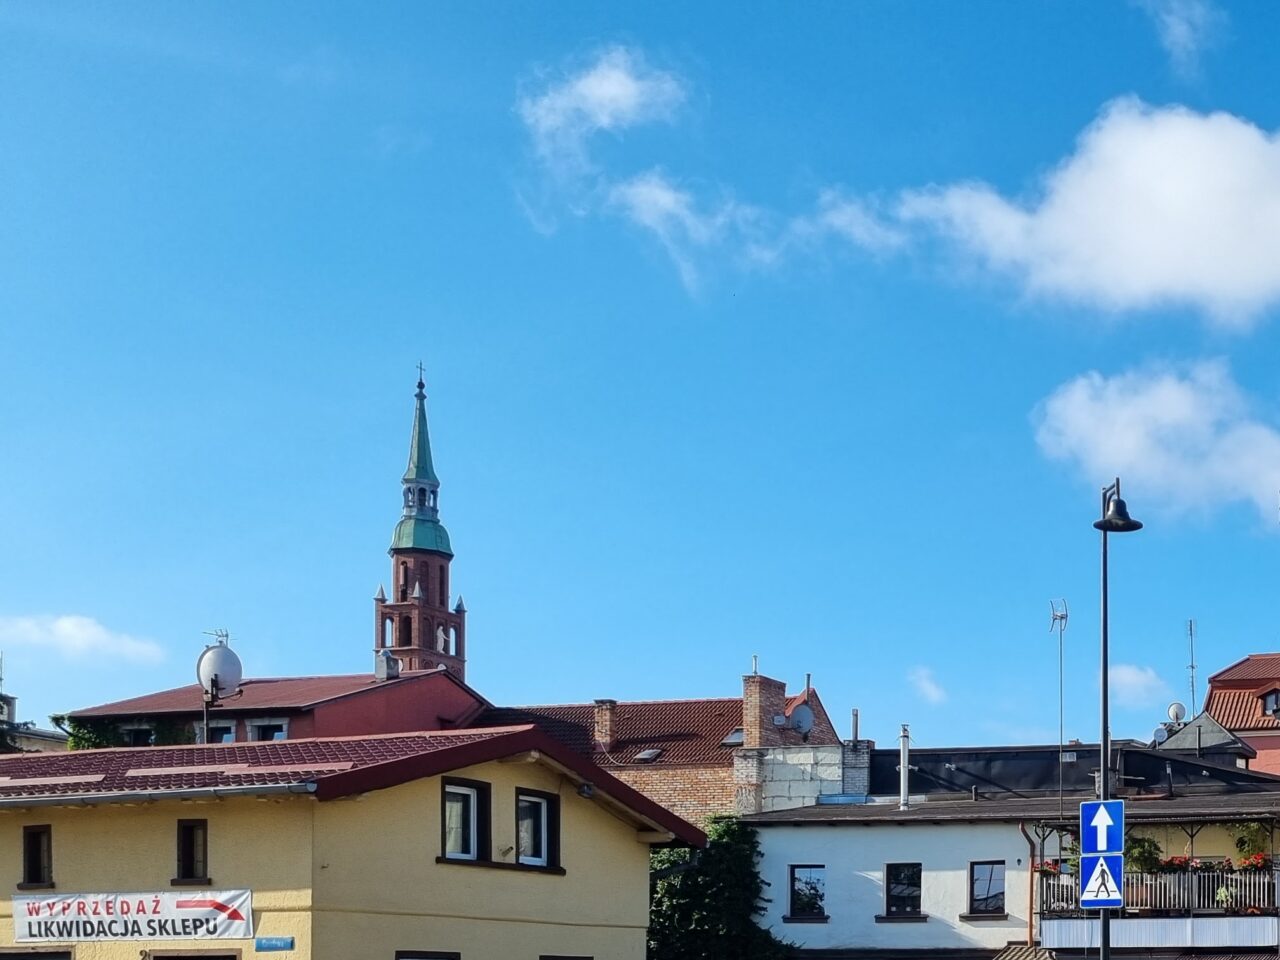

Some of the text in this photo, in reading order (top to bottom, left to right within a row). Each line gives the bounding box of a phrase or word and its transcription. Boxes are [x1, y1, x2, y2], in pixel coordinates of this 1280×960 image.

[27, 895, 161, 917] WYPRZEDAŻ
[28, 917, 218, 938] LIKWIDACJA SKLEPU
